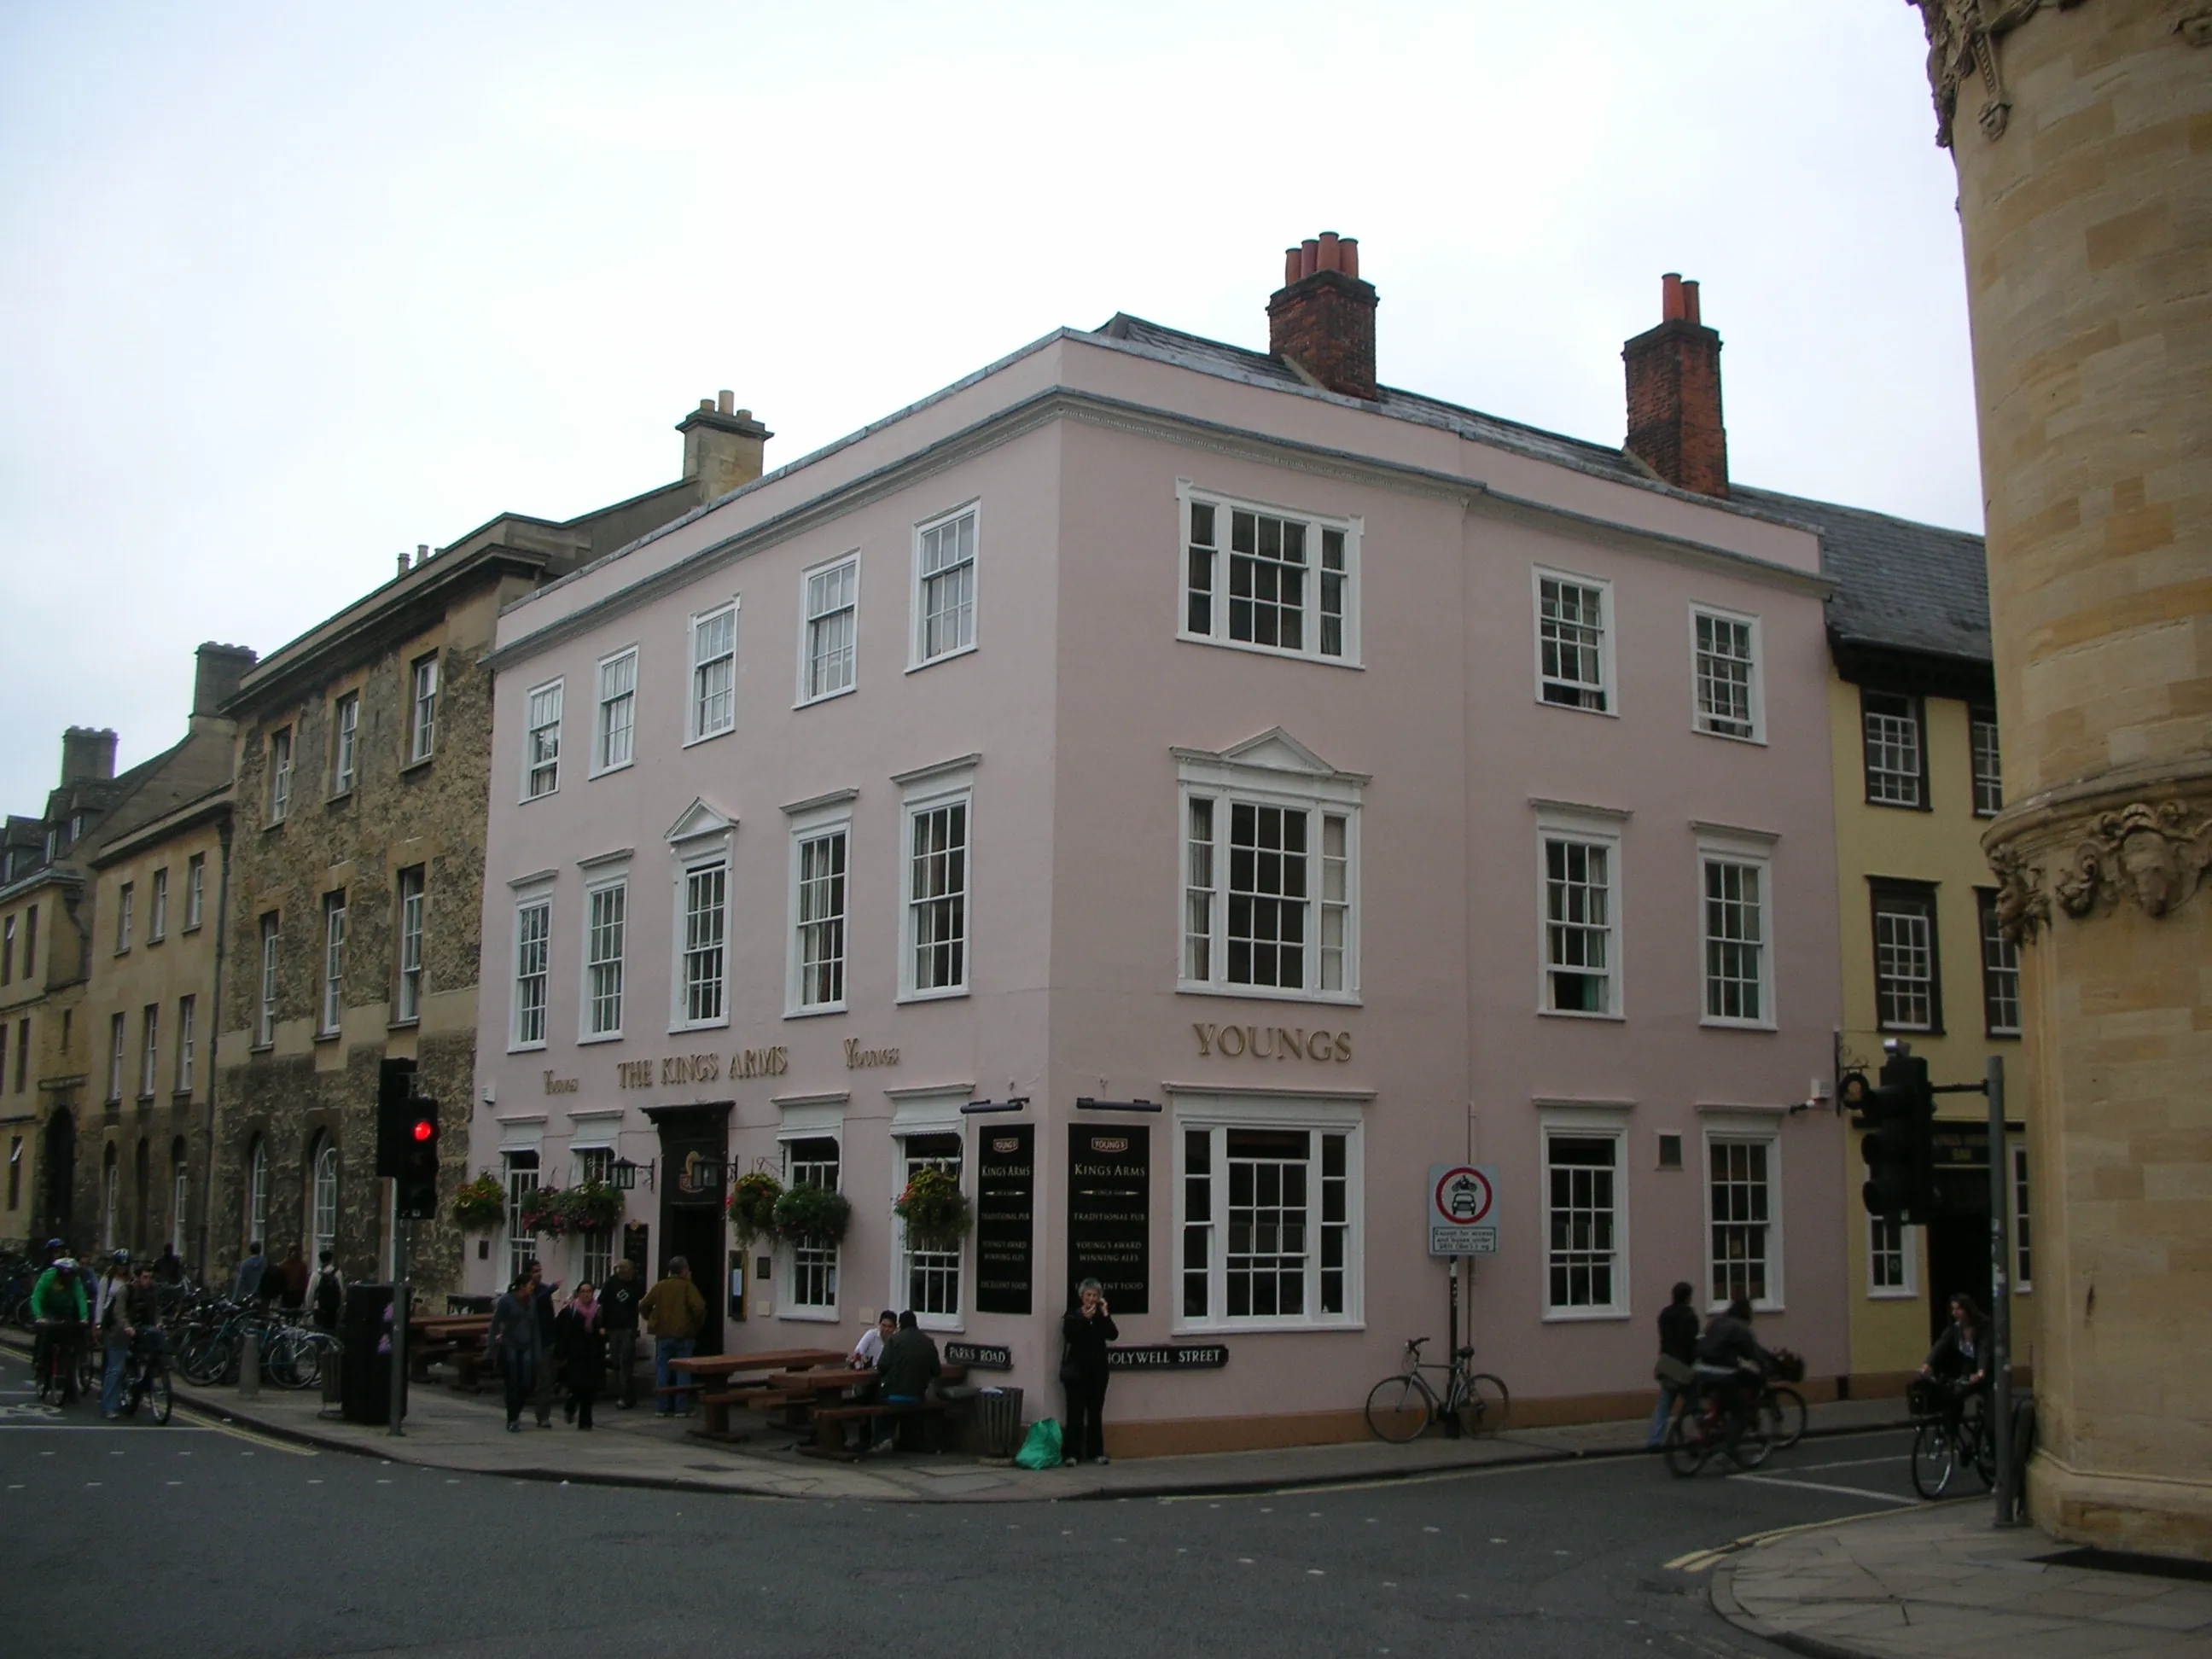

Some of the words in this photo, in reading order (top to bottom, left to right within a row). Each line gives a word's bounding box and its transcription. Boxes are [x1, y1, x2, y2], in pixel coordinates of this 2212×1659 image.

[1193, 1022, 1352, 1062] YOUNGS
[617, 1059, 653, 1089] THE
[661, 1051, 719, 1086] KINGS
[728, 1045, 789, 1080] ARMS
[1007, 1165, 1030, 1177] ARMS
[1074, 1163, 1111, 1176] KINGS
[1115, 1164, 1145, 1177] ARMS
[1074, 1213, 1127, 1221] TRADITIONAL
[1130, 1213, 1145, 1221] PUB
[1114, 1241, 1142, 1249] AWARD
[950, 1347, 975, 1359] PARKS
[980, 1349, 1006, 1363] ROAD
[1178, 1348, 1221, 1363] STREET
